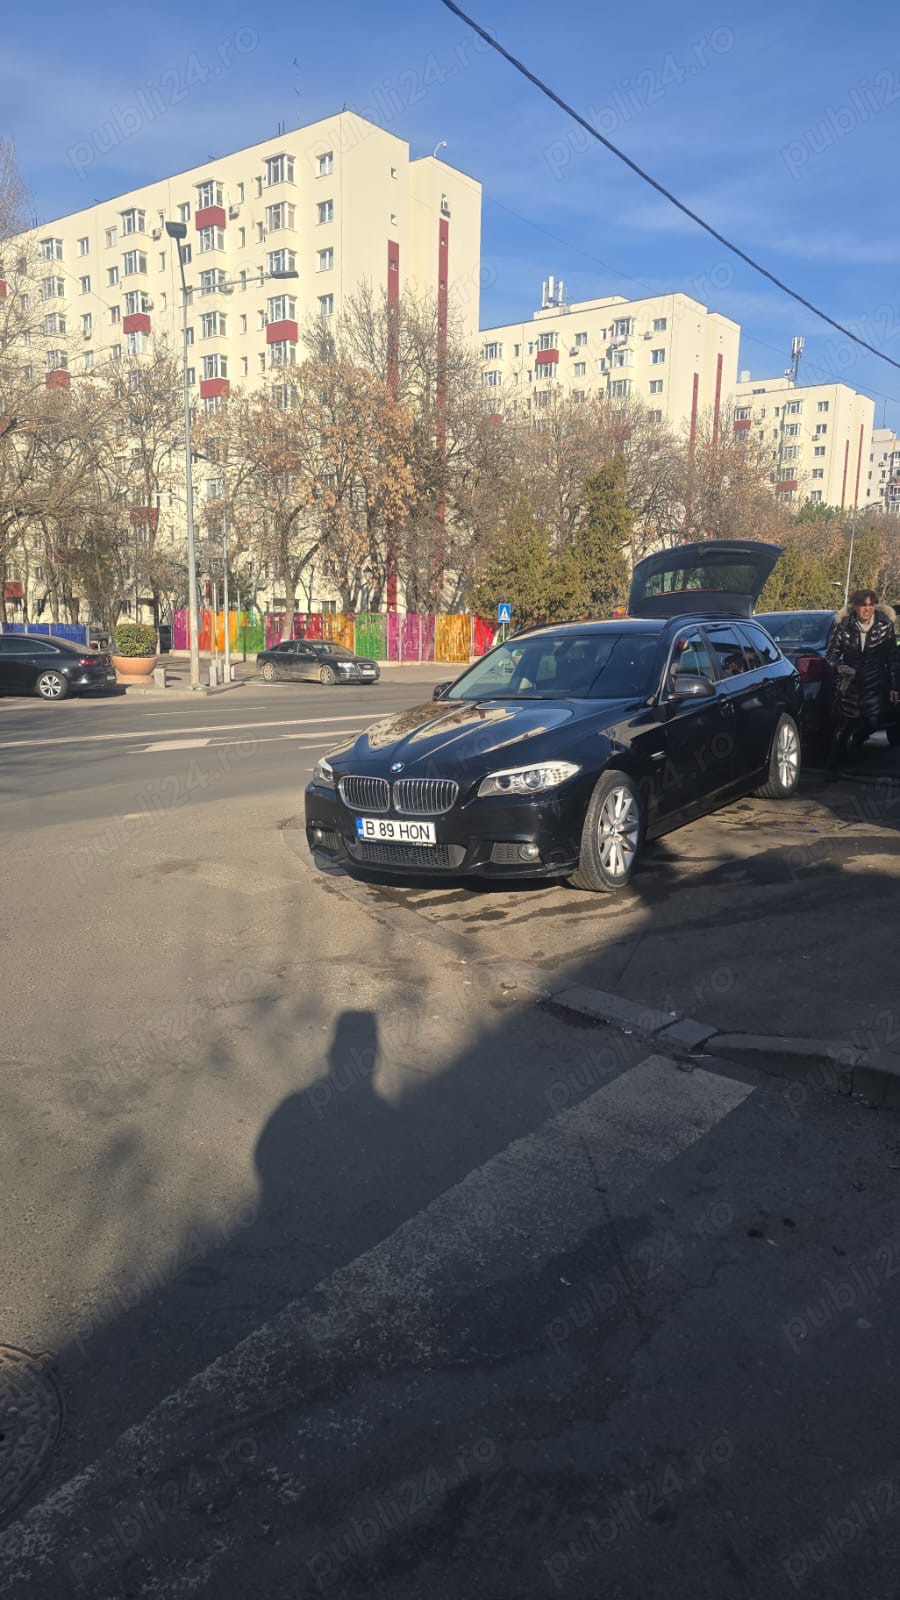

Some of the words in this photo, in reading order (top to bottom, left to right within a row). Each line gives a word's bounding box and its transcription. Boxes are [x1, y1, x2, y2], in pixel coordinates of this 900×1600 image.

[366, 821, 375, 835] B
[379, 823, 395, 837] 89
[399, 824, 429, 840] HON
